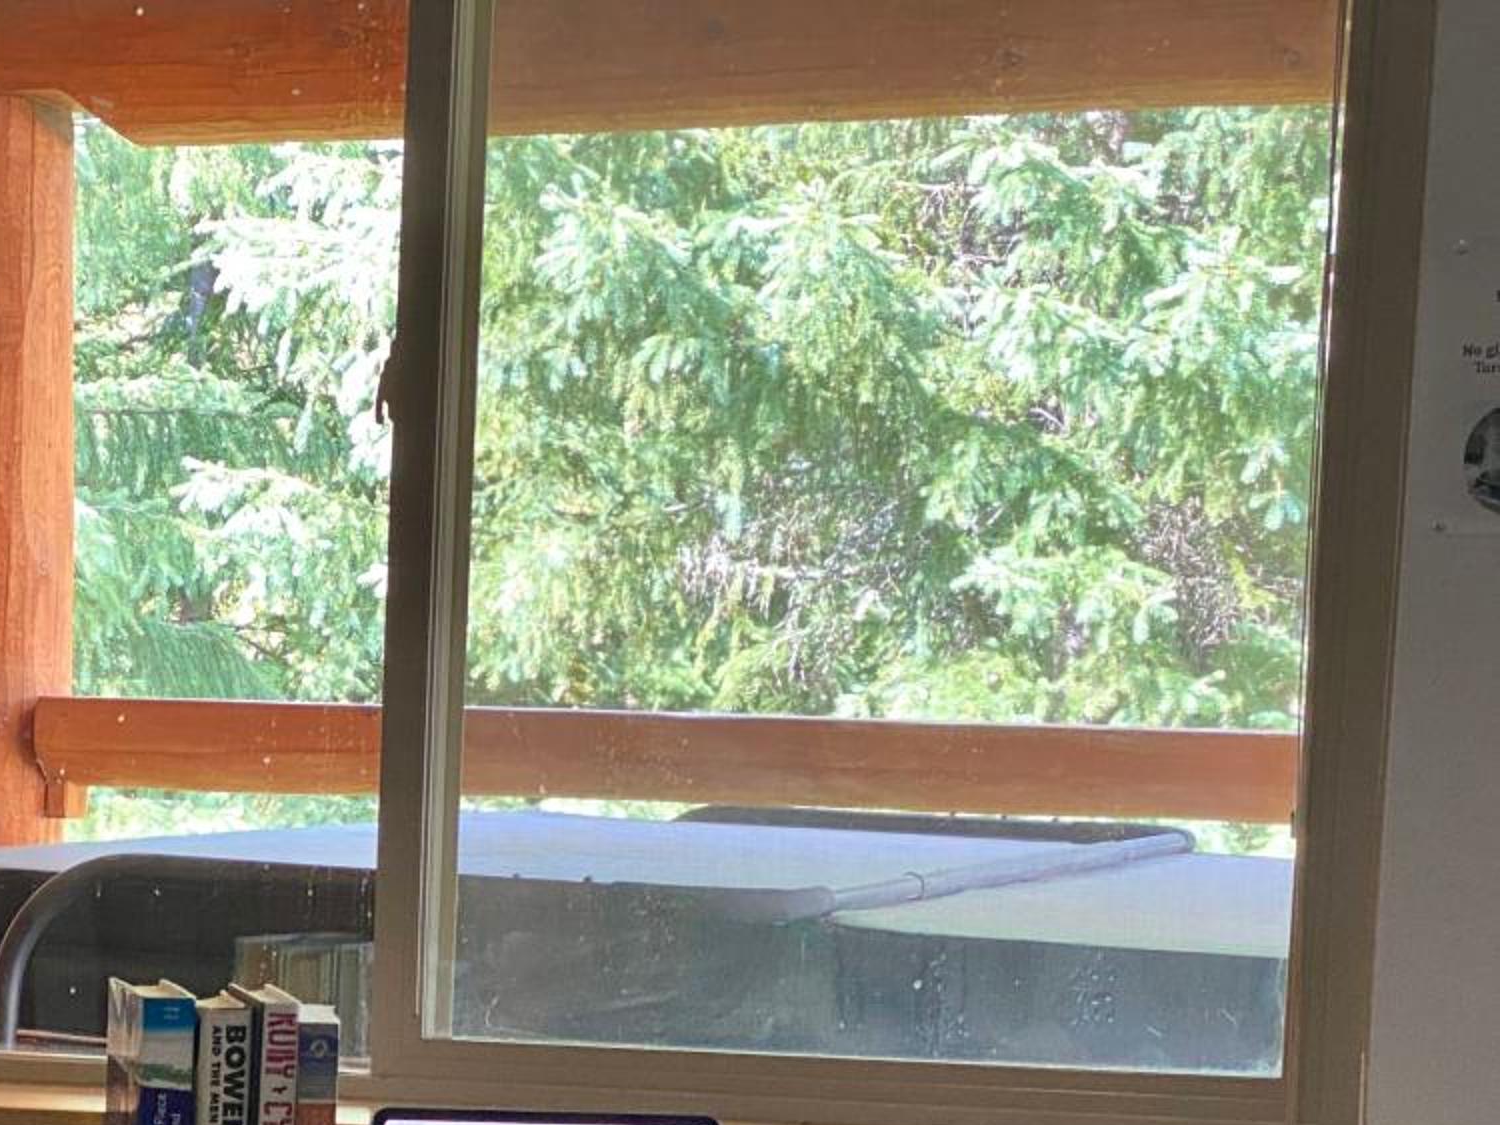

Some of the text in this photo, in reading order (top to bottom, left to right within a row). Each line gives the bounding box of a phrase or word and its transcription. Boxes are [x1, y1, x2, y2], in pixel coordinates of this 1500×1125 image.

[212, 1026, 223, 1056] AND
[211, 1062, 222, 1089] THE
[209, 1093, 221, 1124] MEN
